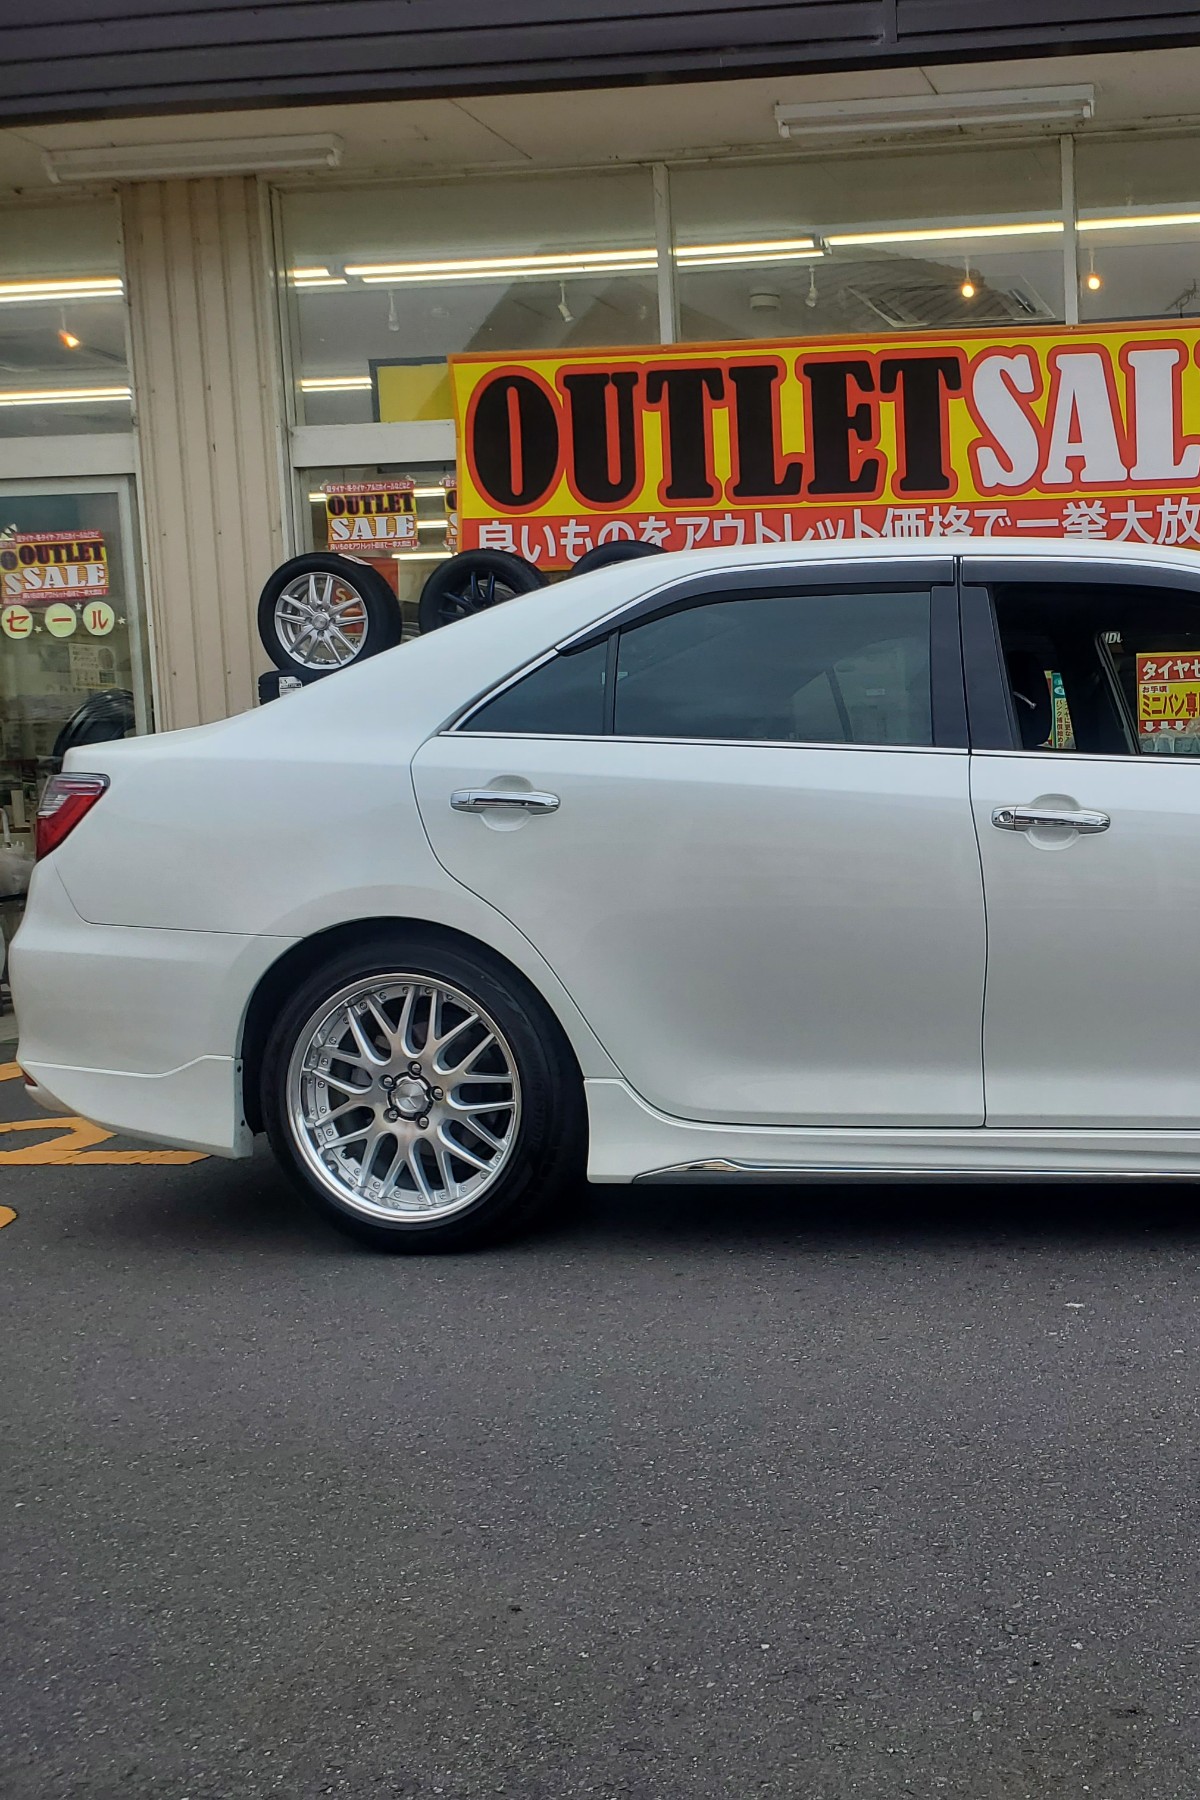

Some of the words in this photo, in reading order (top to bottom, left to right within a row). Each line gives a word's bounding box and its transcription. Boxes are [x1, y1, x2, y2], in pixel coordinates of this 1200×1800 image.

[471, 354, 964, 508] OUTLET
[327, 492, 414, 516] OUTLET
[330, 515, 415, 541] SALE
[18, 541, 104, 566] OUTLET
[22, 563, 106, 591] SALE
[6, 609, 109, 632] セール
[1141, 685, 1168, 693] お手頃
